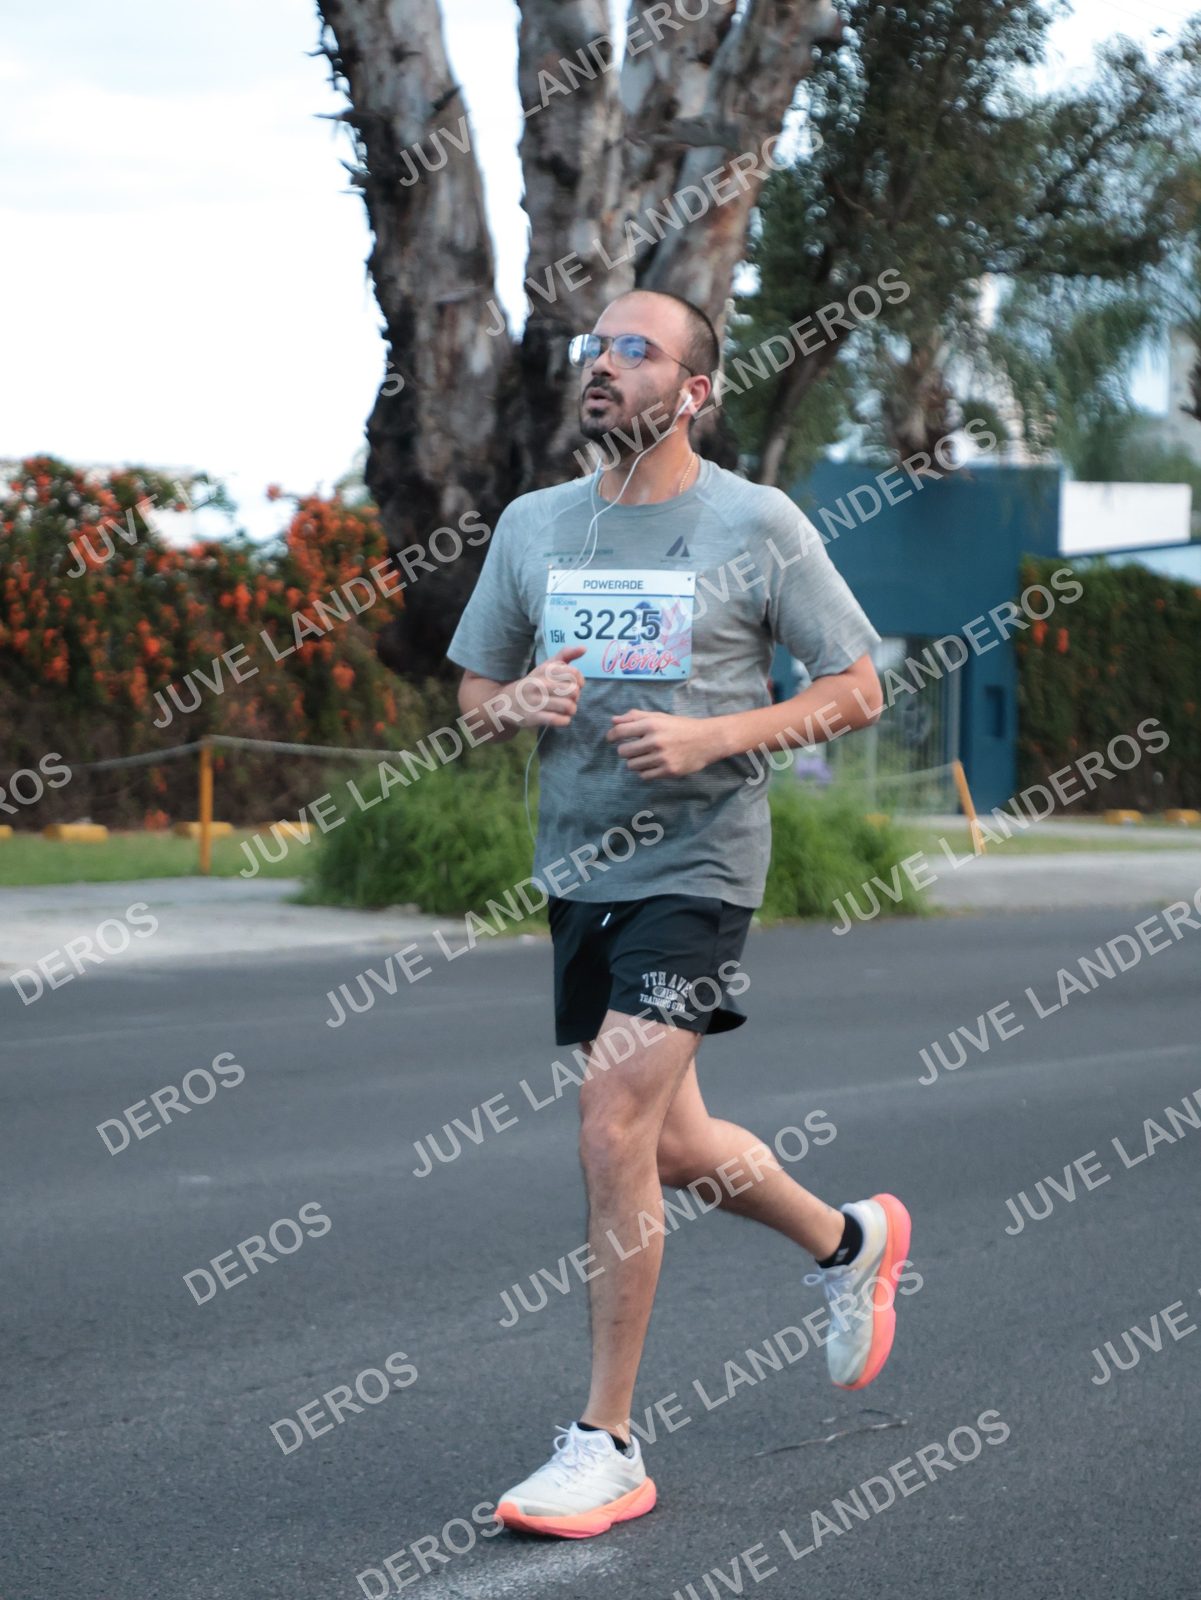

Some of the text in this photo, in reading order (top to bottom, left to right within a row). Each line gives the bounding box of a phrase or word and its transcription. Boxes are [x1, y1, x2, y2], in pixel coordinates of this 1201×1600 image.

[583, 579, 644, 590] POWERADE
[573, 608, 661, 641] 3225
[550, 629, 565, 643] 15k
[641, 971, 666, 988] 7TH
